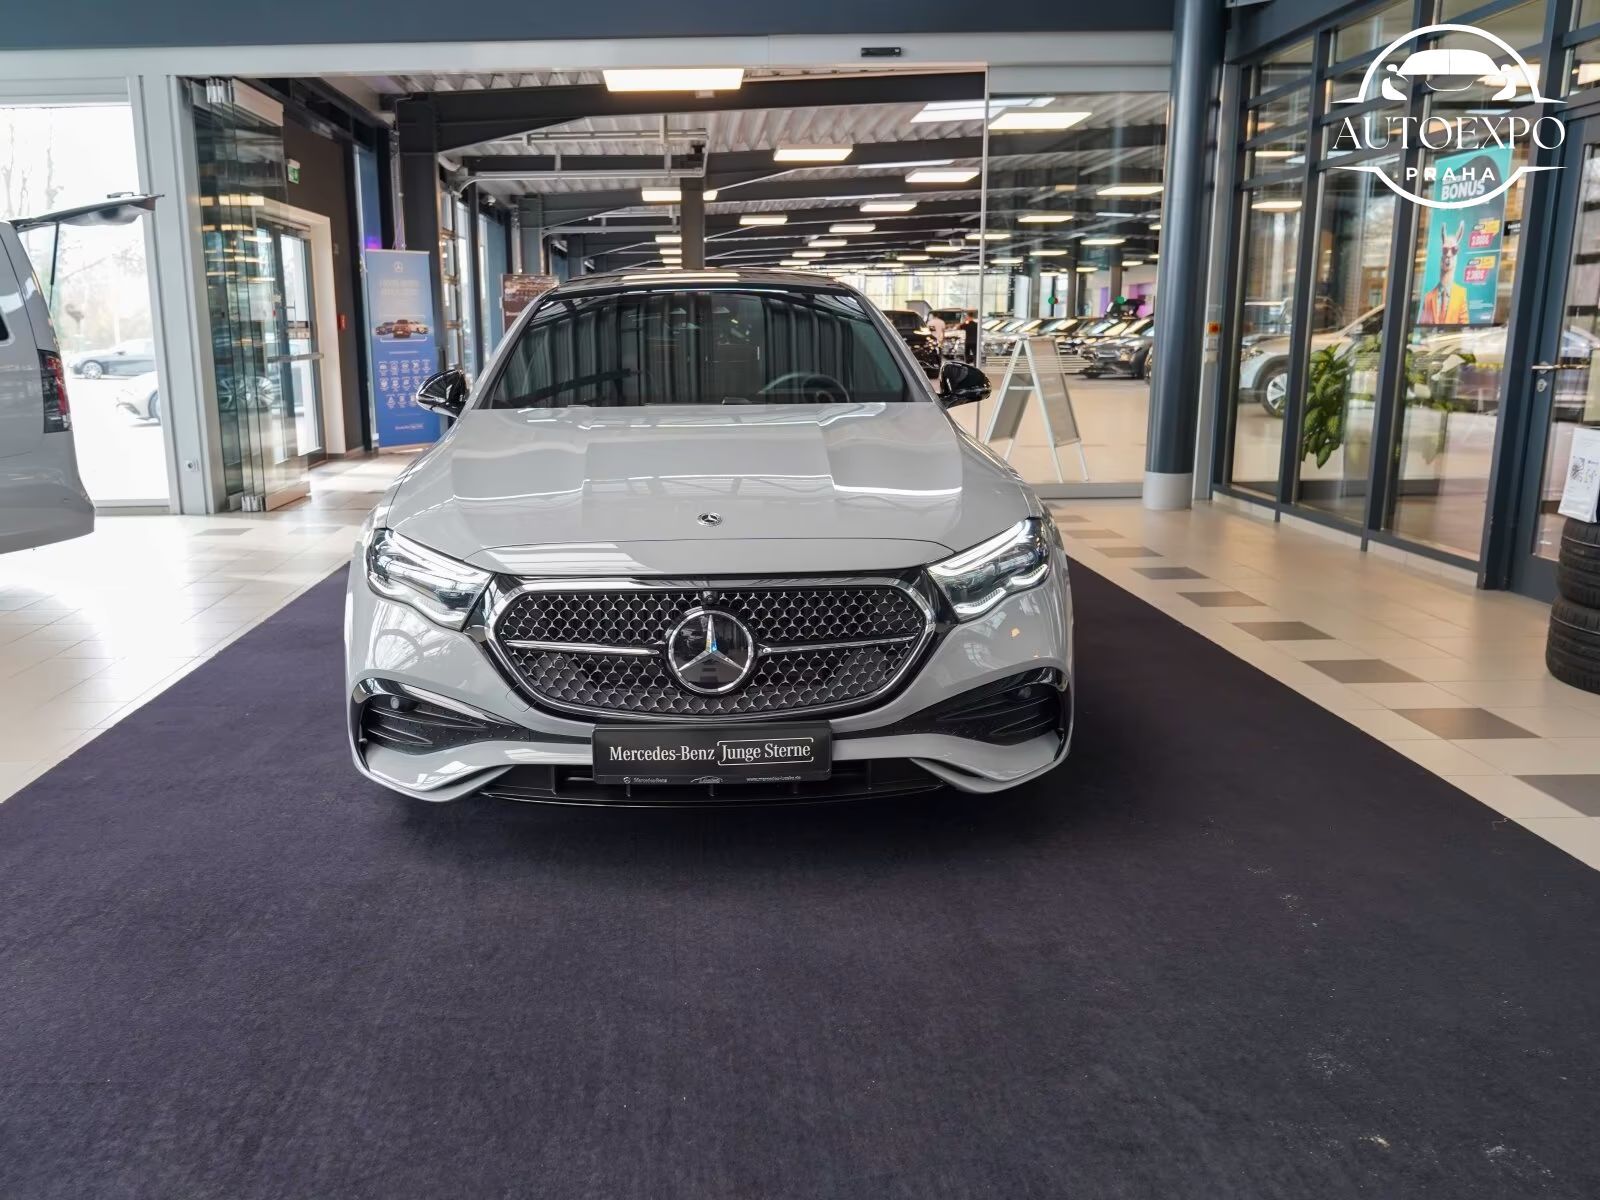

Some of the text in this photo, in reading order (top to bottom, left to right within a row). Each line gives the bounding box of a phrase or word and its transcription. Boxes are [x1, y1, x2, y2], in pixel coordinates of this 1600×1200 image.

[1441, 180, 1486, 201] BONUS
[609, 743, 811, 762] Mercedes-Benz Junge Sterne
